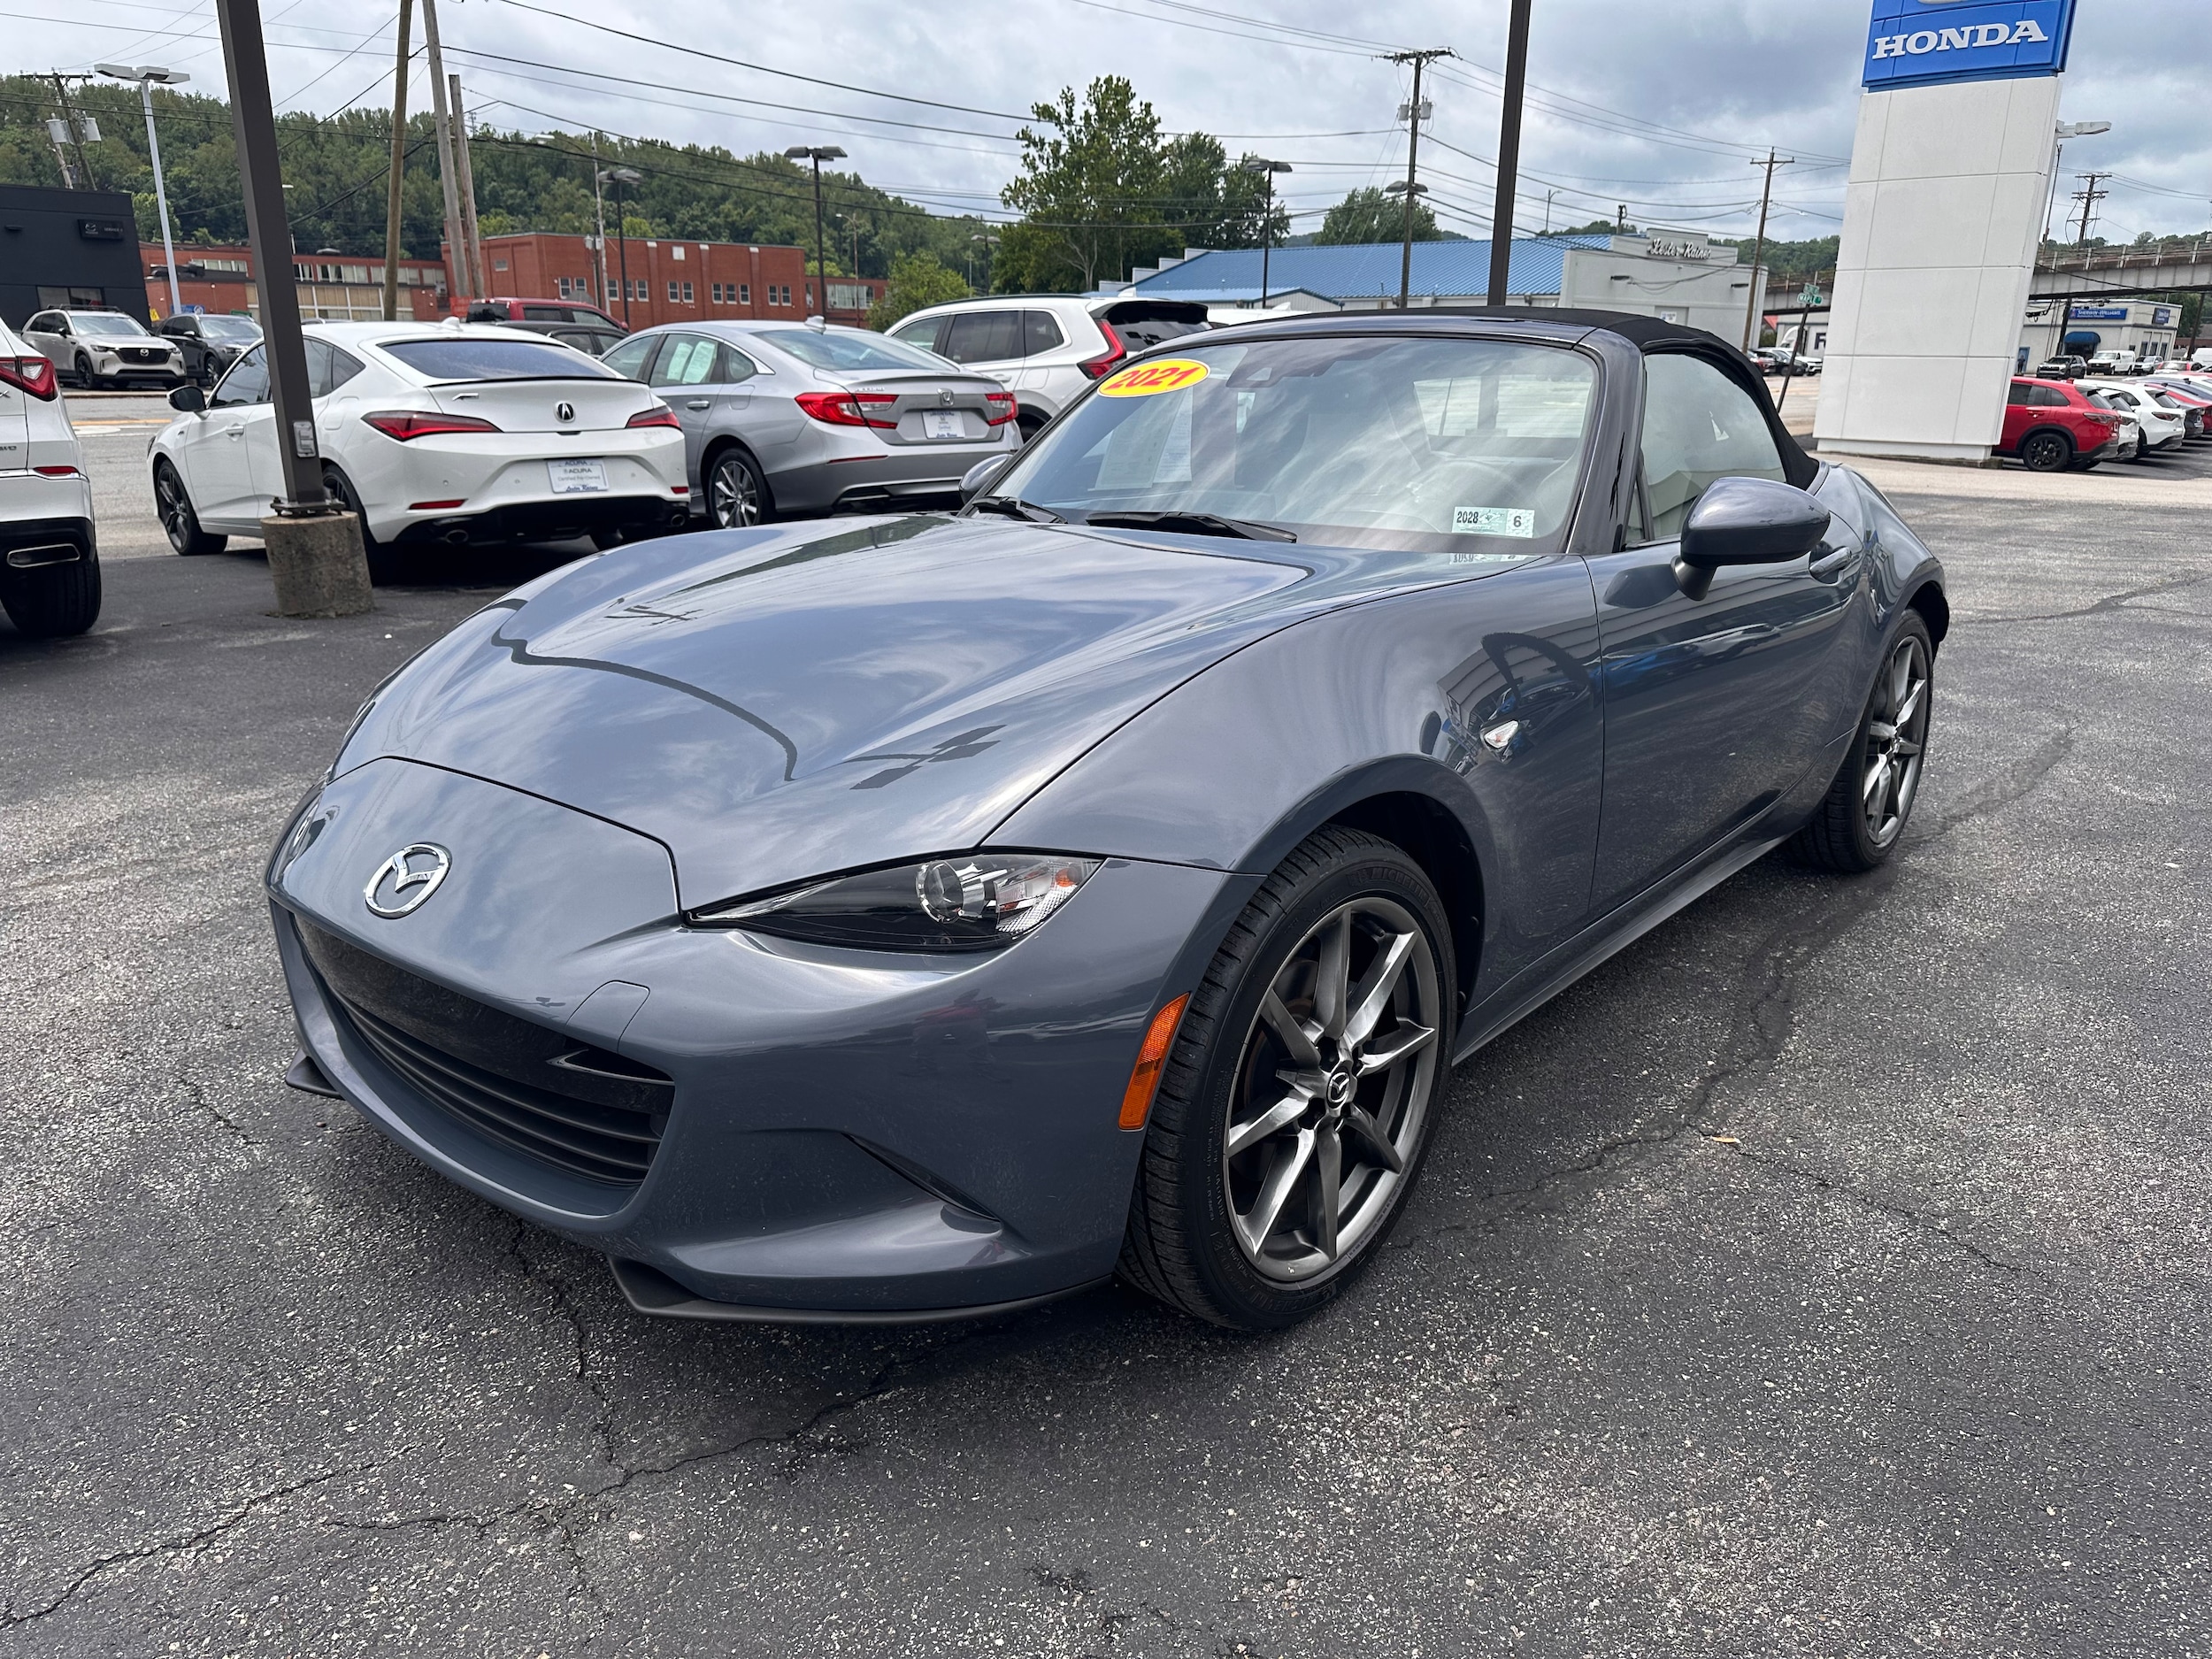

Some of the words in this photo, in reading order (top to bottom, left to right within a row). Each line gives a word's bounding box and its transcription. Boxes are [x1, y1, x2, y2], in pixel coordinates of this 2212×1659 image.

[1871, 19, 2048, 59] HONDA
[1647, 237, 1680, 257] Lester
[1104, 366, 1201, 390] 2021
[1456, 511, 1479, 524] 2028
[1513, 515, 1522, 527] 6
[1371, 867, 1430, 904] MICHELIN
